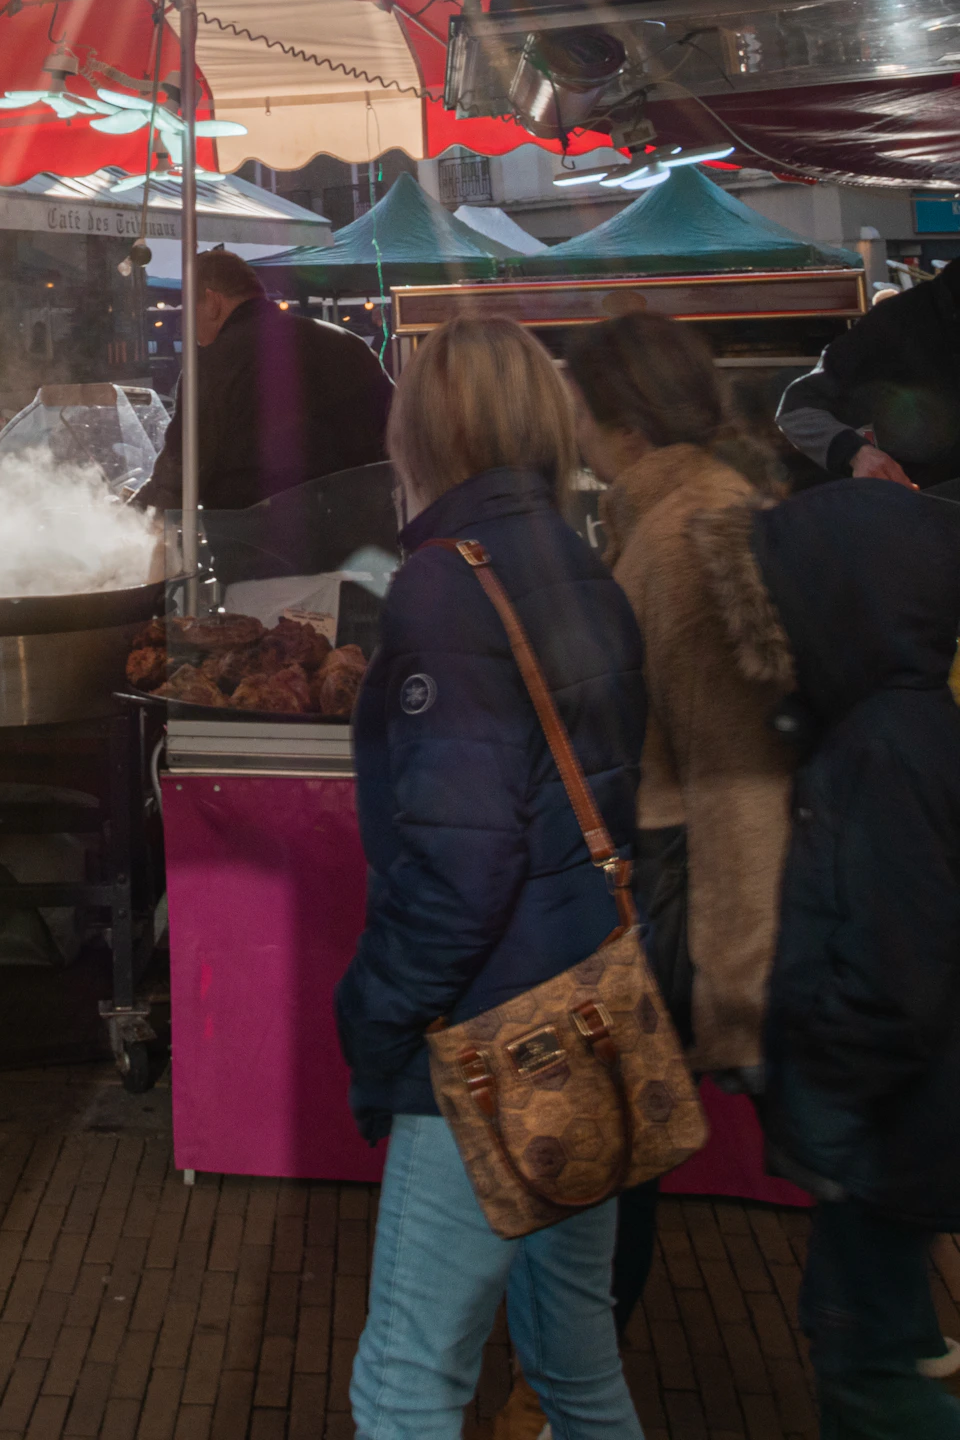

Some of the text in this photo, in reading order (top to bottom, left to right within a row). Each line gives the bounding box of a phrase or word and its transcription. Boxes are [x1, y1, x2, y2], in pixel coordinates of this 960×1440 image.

[47, 207, 176, 236] Café des Tribnaux
